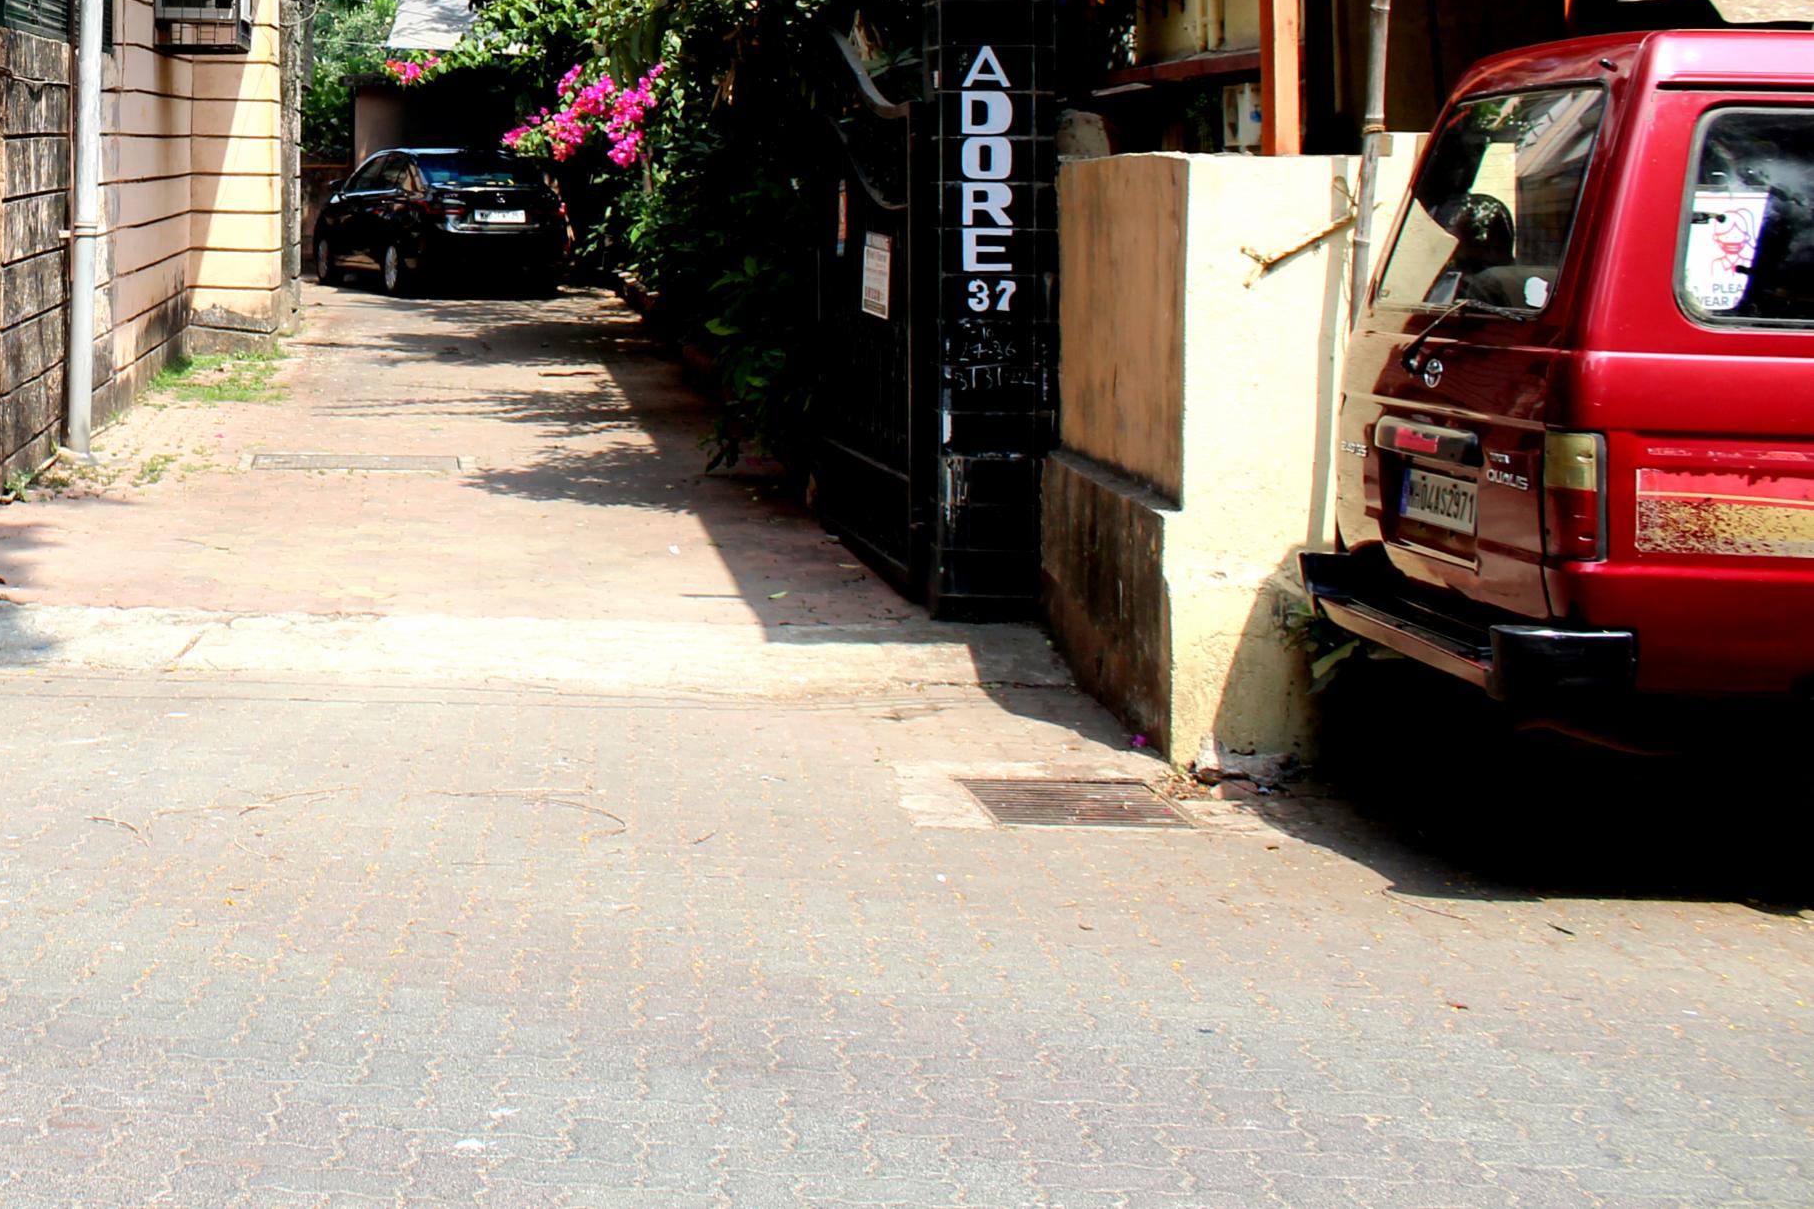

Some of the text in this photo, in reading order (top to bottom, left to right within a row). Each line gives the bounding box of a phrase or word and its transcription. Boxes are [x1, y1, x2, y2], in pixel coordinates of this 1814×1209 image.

[961, 45, 1014, 272] ADORE
[967, 278, 1017, 312] 37
[1712, 283, 1743, 293] PLEA
